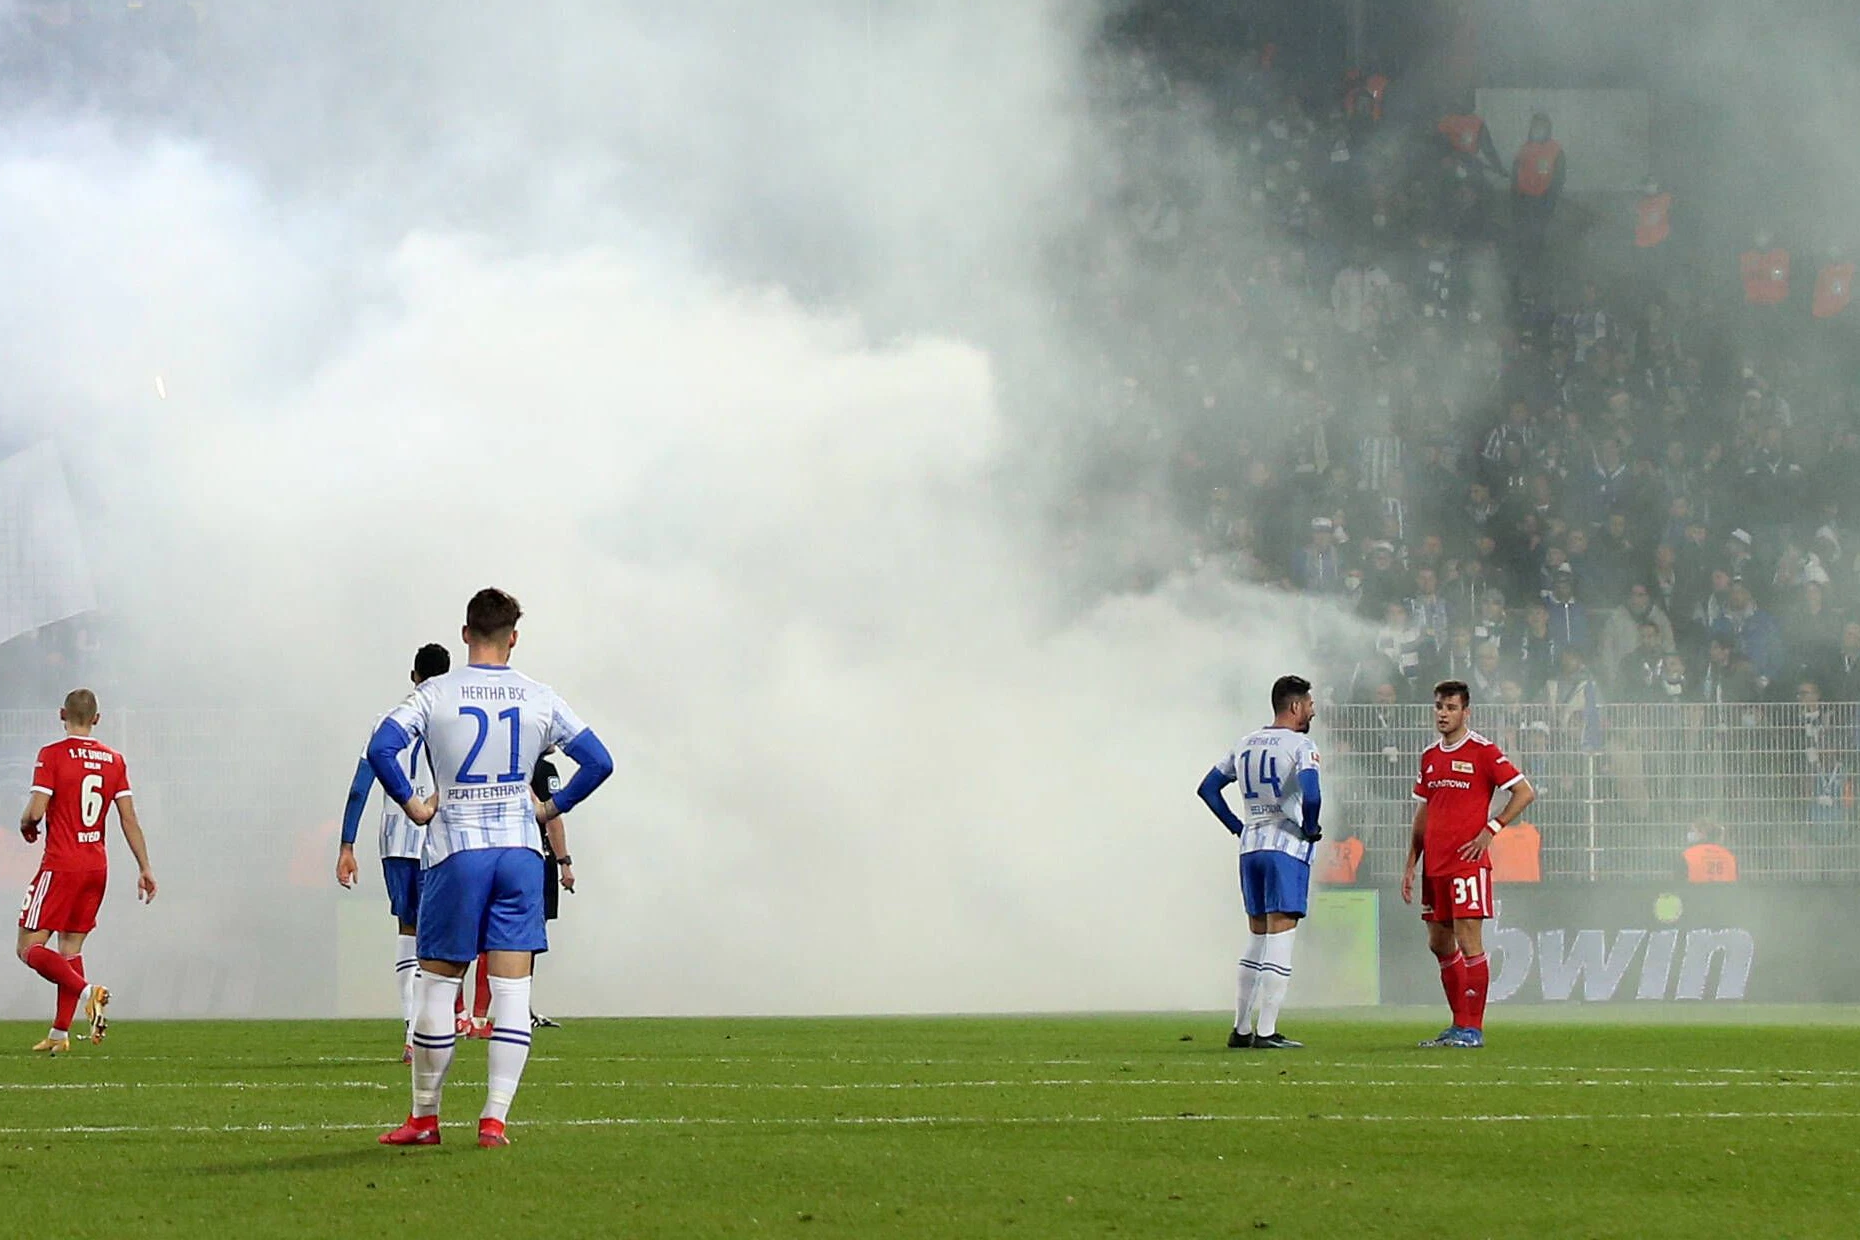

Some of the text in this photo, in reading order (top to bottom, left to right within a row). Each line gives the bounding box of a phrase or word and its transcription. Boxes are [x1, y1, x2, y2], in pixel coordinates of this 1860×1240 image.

[461, 685, 528, 702] HERTHA BSC
[455, 706, 526, 784] 21
[1240, 749, 1282, 798] 14
[81, 774, 104, 828] 6
[1453, 876, 1479, 905] 31
[1484, 898, 1754, 1003] bwin
